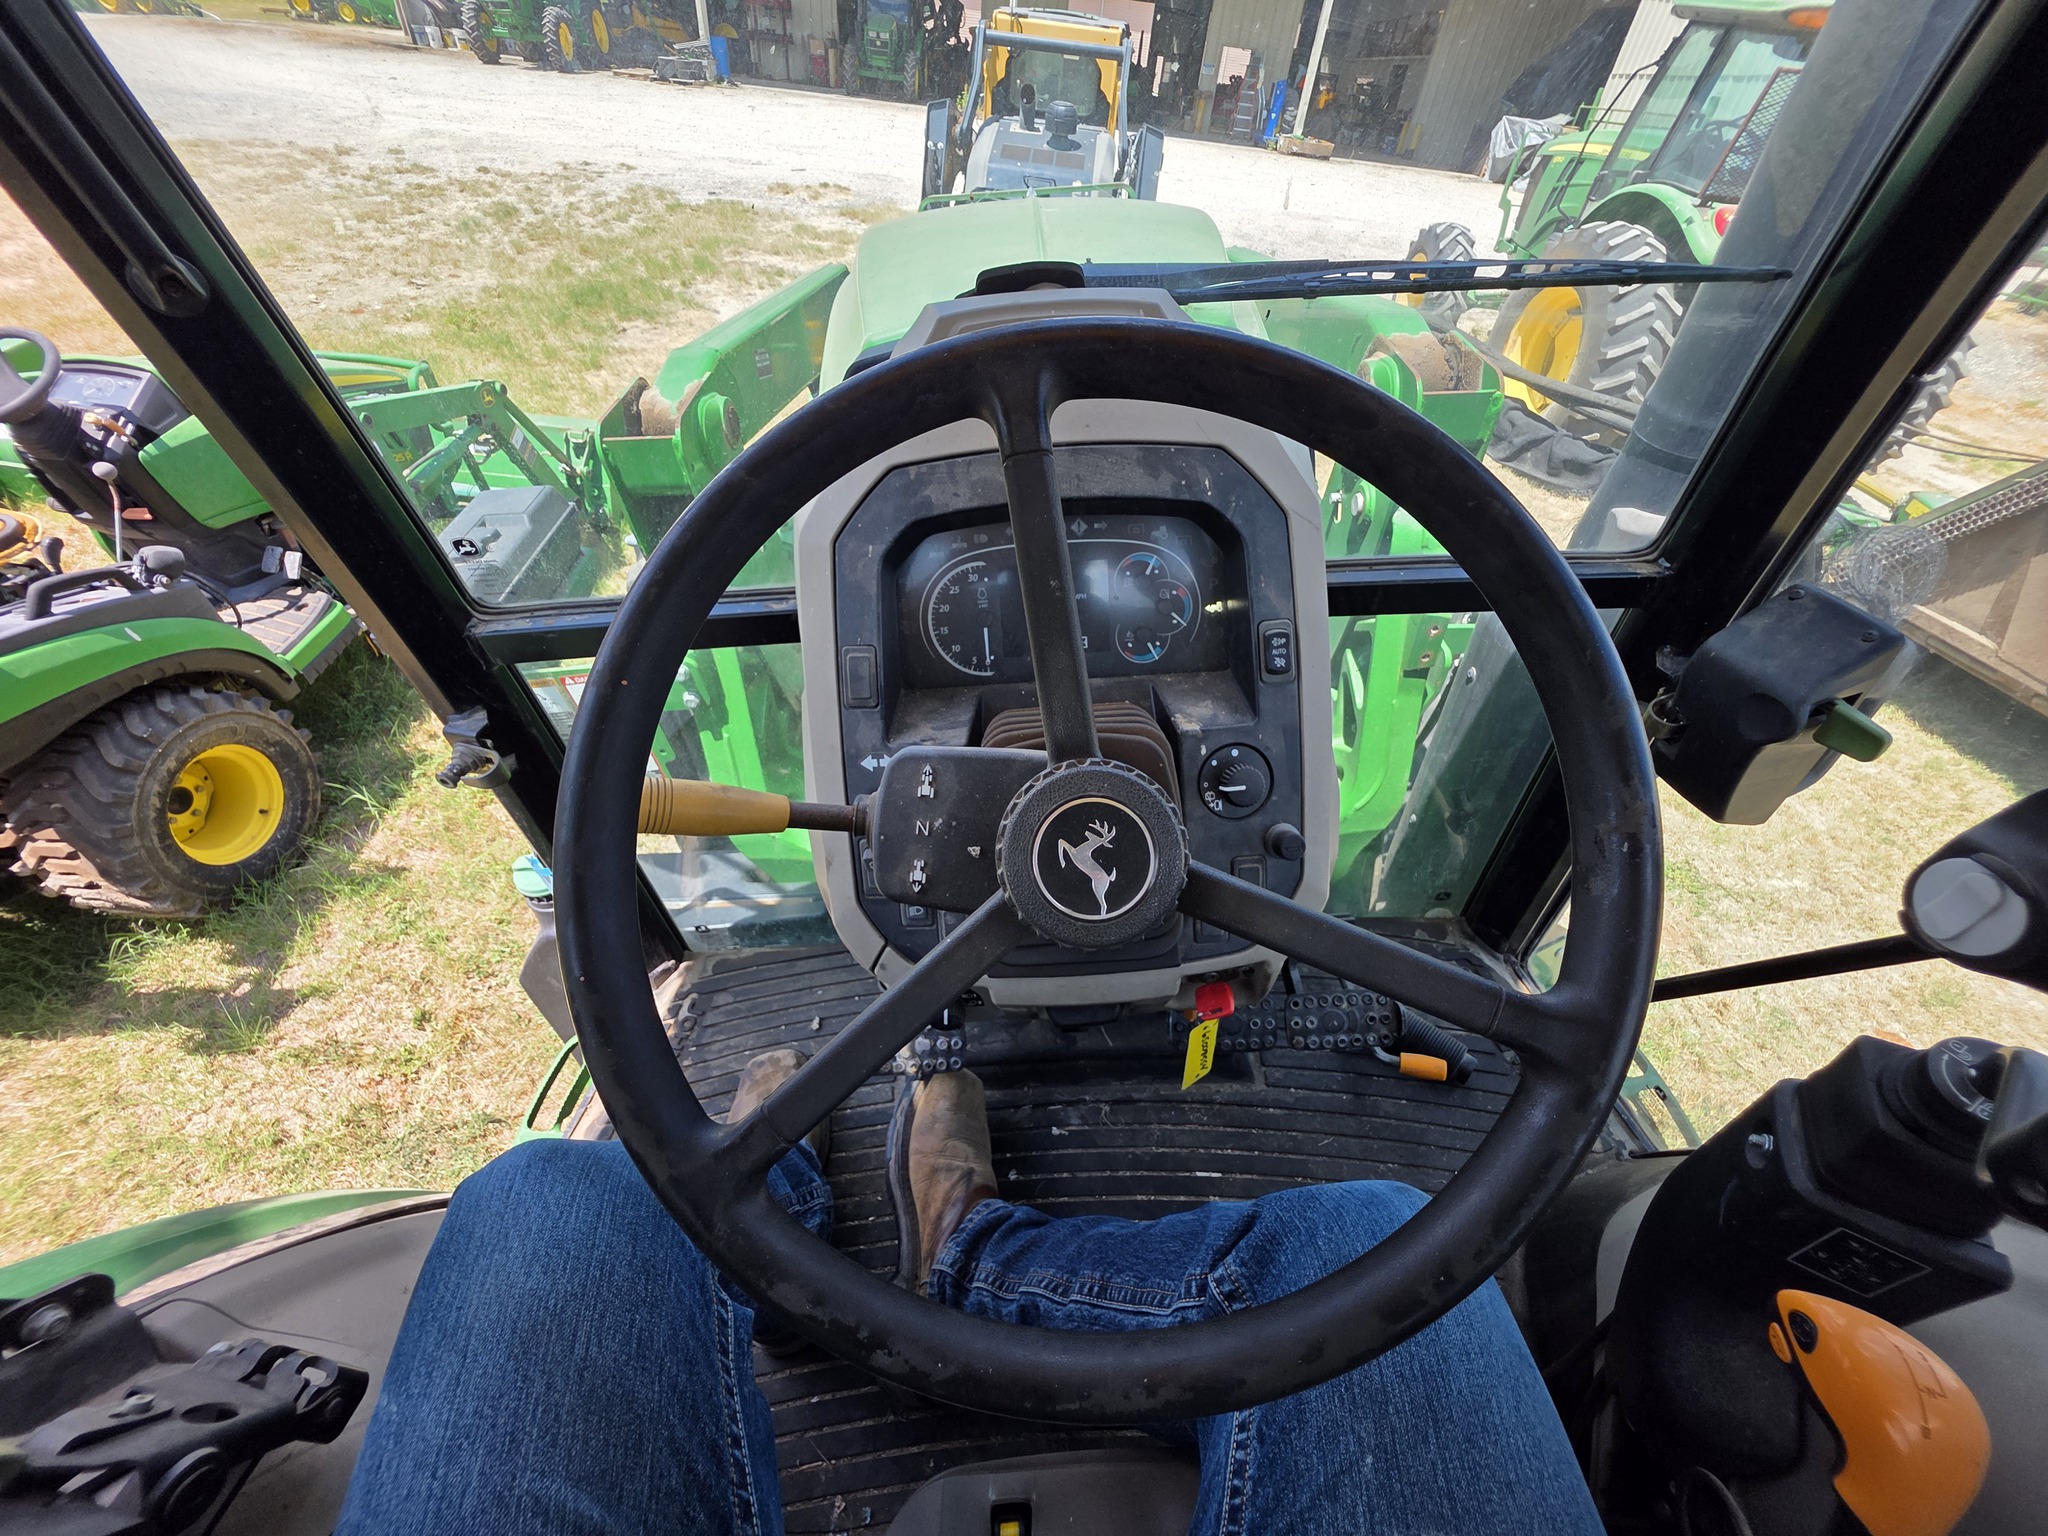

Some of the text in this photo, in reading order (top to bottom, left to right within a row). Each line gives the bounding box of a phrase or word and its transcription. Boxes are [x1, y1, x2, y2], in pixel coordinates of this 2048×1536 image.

[967, 573, 979, 583] 30
[949, 585, 960, 595] 25
[938, 604, 950, 613] 20
[940, 626, 949, 635] 15
[951, 644, 961, 653] 10
[971, 656, 978, 665] 5
[915, 820, 930, 836] N
